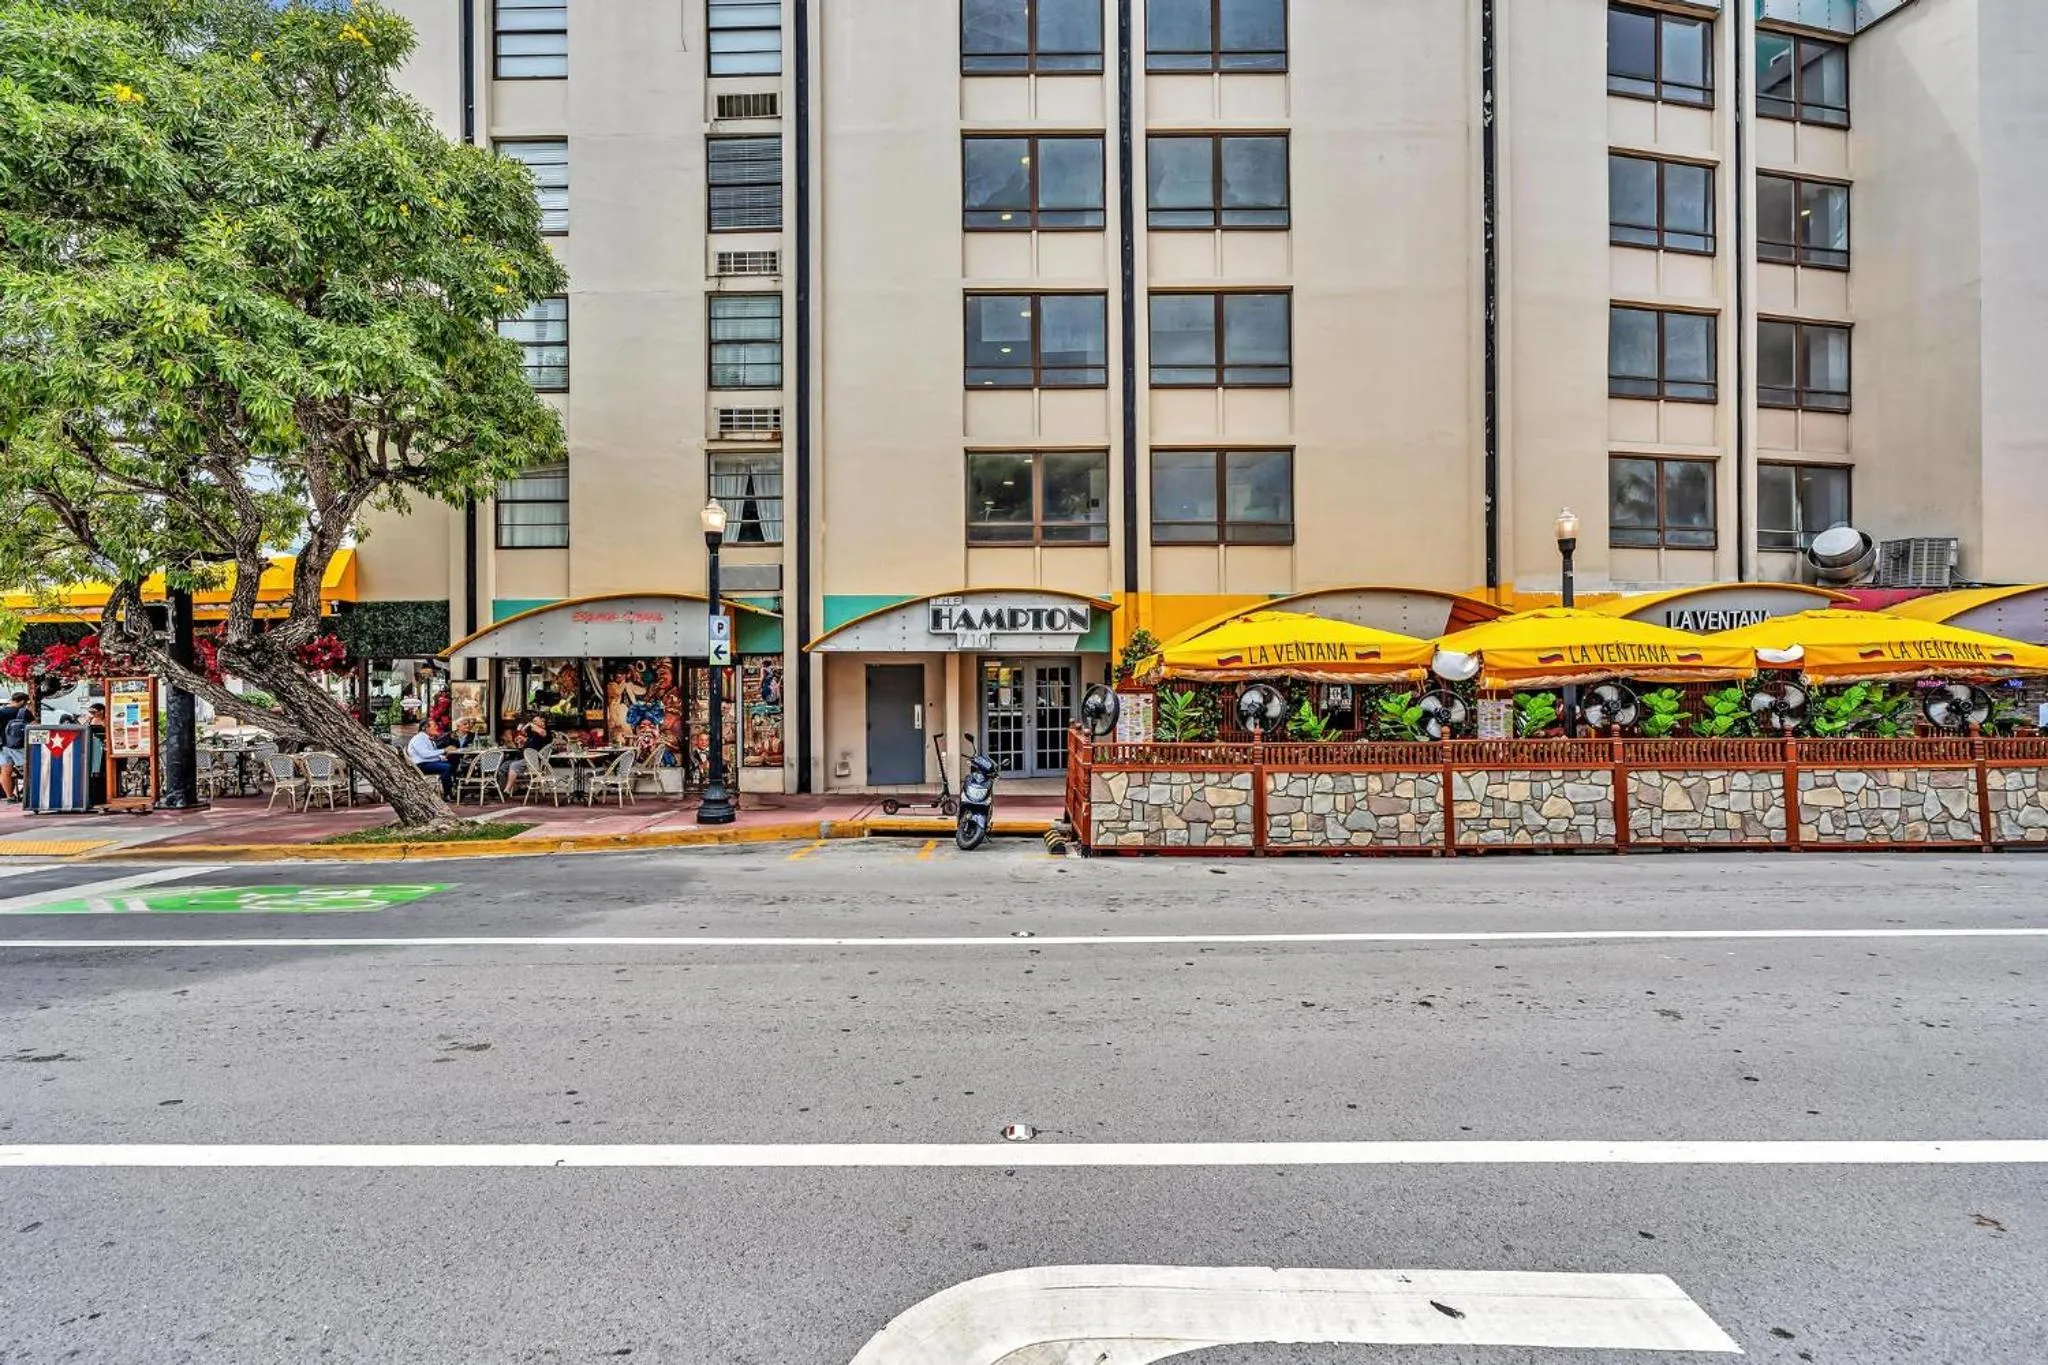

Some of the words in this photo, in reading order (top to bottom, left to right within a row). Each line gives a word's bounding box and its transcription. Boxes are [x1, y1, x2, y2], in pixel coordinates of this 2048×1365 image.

[717, 621, 725, 634] P
[931, 607, 1089, 631] HAMPTON
[1667, 610, 1692, 629] LA
[959, 633, 988, 648] 710
[1887, 640, 1911, 660] LA
[1913, 640, 1986, 660] VENTANA
[1248, 645, 1269, 665] LA
[1273, 641, 1349, 662] VENTANA
[1568, 645, 1591, 664] LA
[1594, 642, 1671, 663] VENTANA
